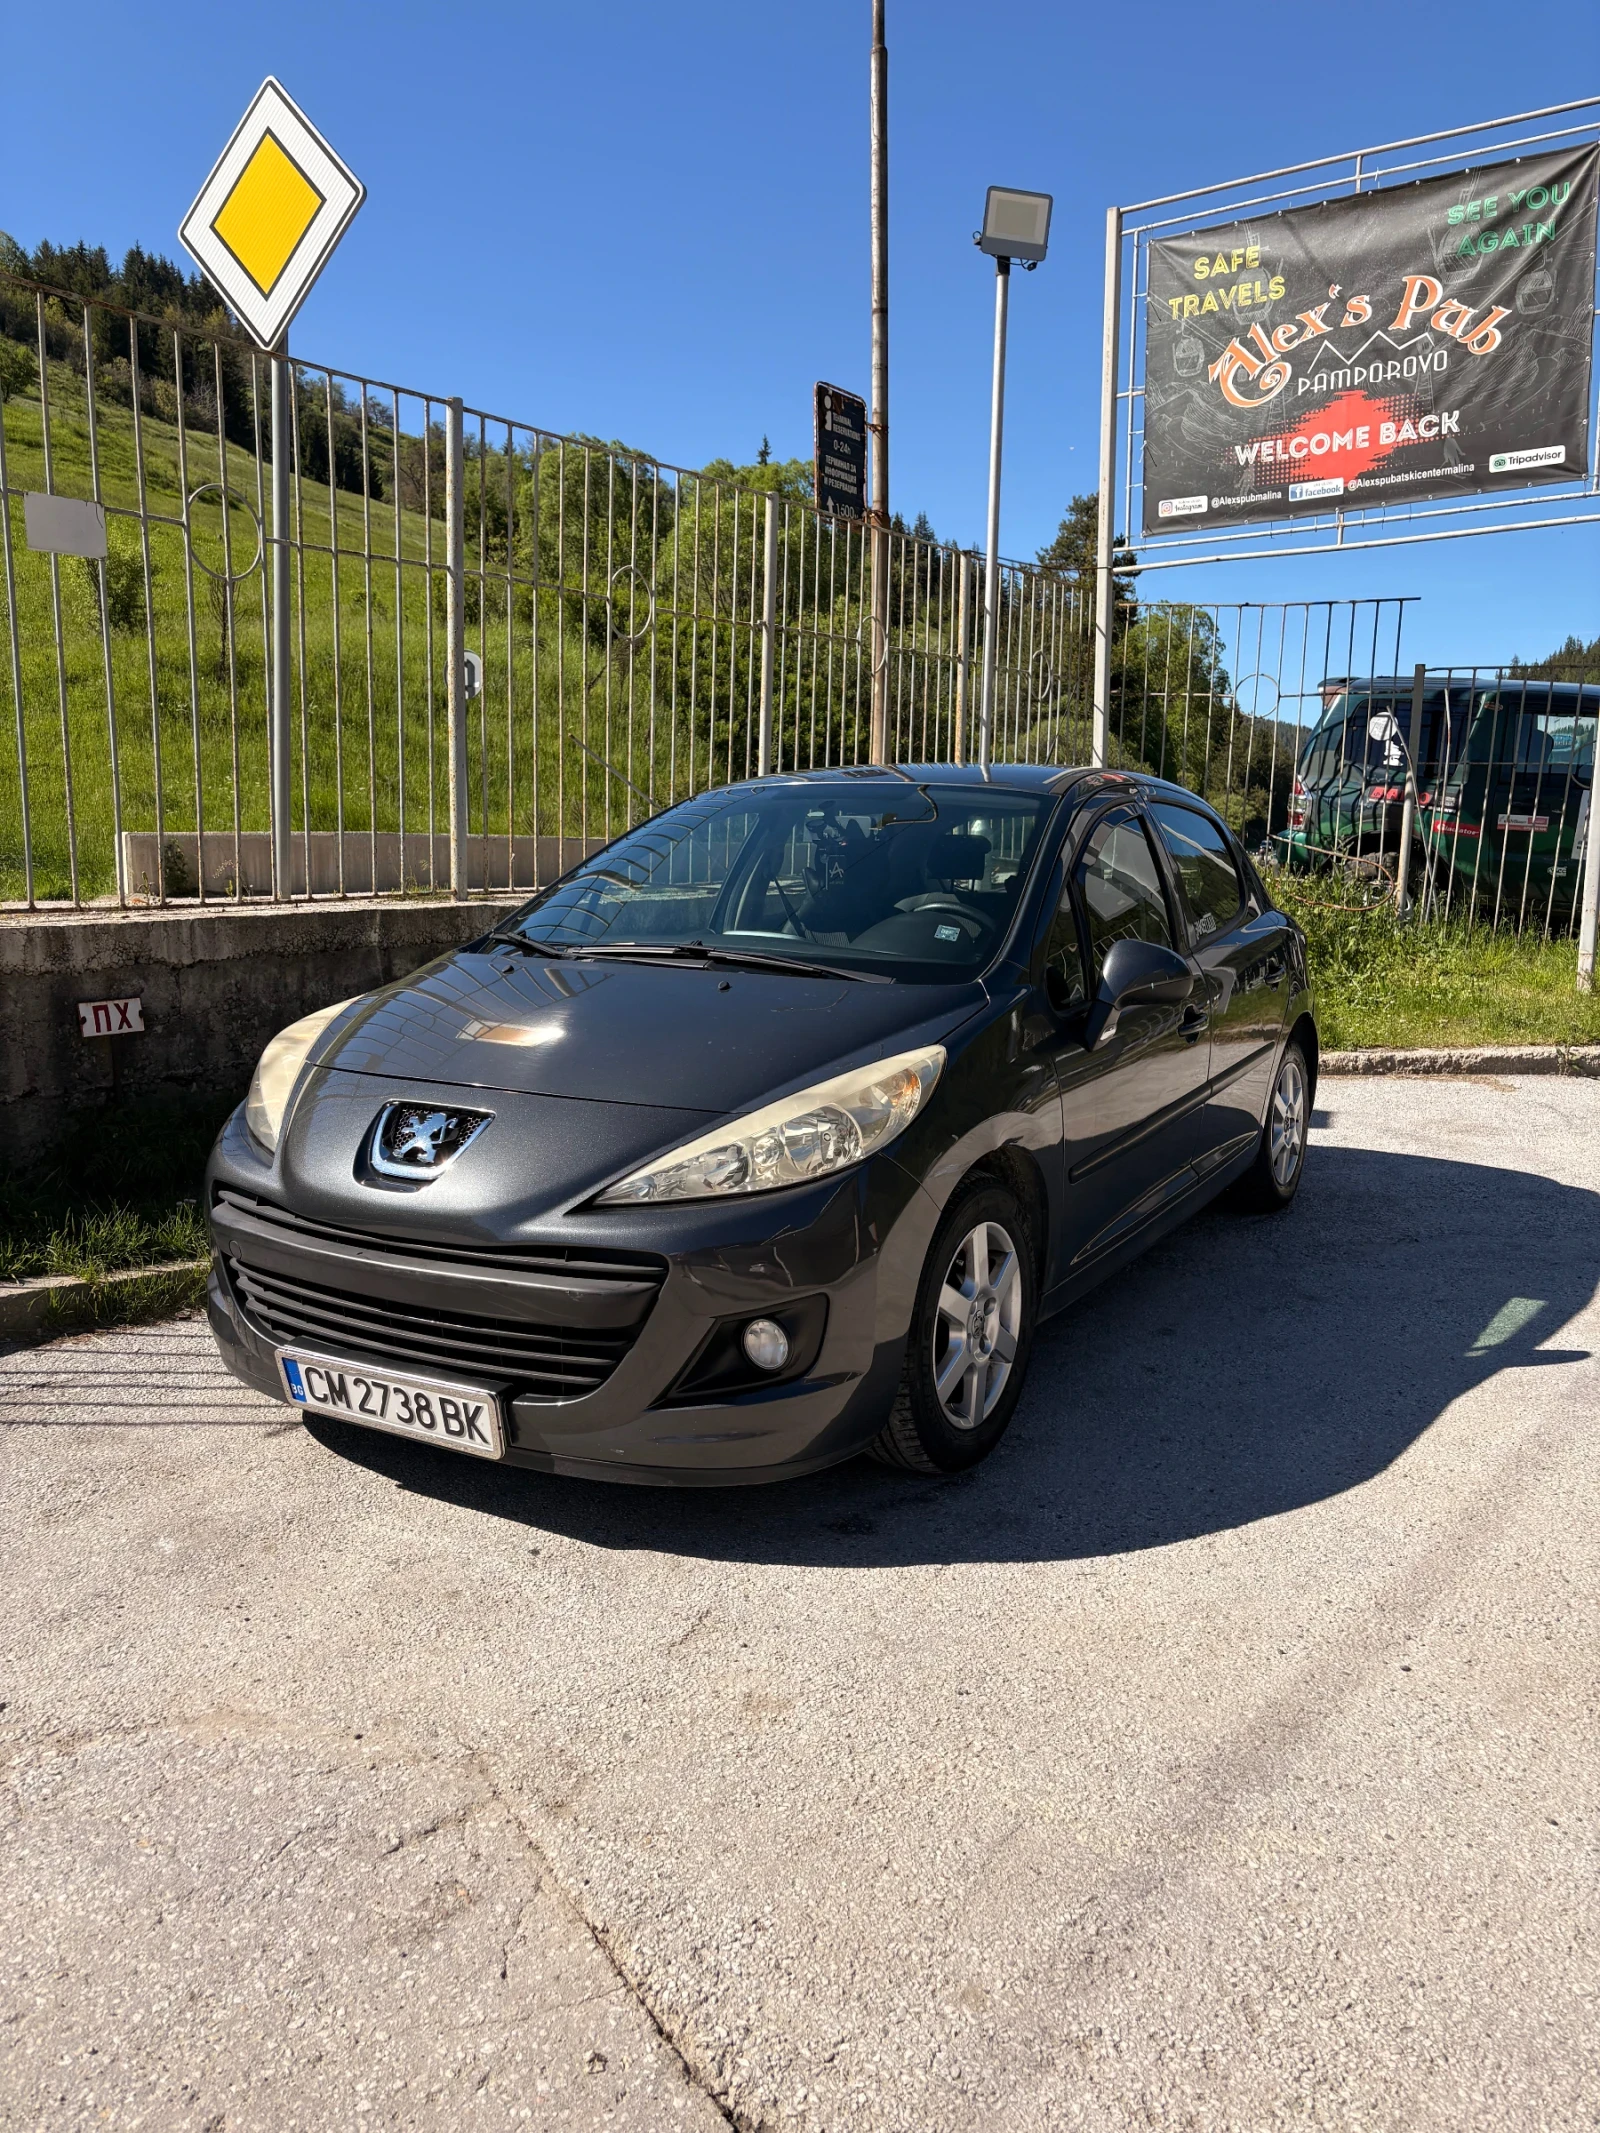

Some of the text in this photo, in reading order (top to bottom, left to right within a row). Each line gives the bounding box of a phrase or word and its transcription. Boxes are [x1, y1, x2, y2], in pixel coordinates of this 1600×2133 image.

[1447, 181, 1570, 225] SEE YOU
[1456, 218, 1557, 257] AGAIN
[1193, 244, 1260, 280] SAFE
[1168, 276, 1286, 321] TRAVELS
[1208, 283, 1373, 408] Alex's
[1298, 350, 1448, 396] PAMPOROVO
[1234, 410, 1460, 466] WELCOME BACK
[1508, 450, 1562, 466] Tripadvisor
[1305, 484, 1341, 497] facebook
[1348, 462, 1475, 492] @Alexspubatskicentermalina
[1211, 491, 1282, 508] @Alexspubmalina
[1437, 823, 1479, 835] Glaator
[92, 1002, 133, 1033] ПХ
[291, 1382, 304, 1396] BG
